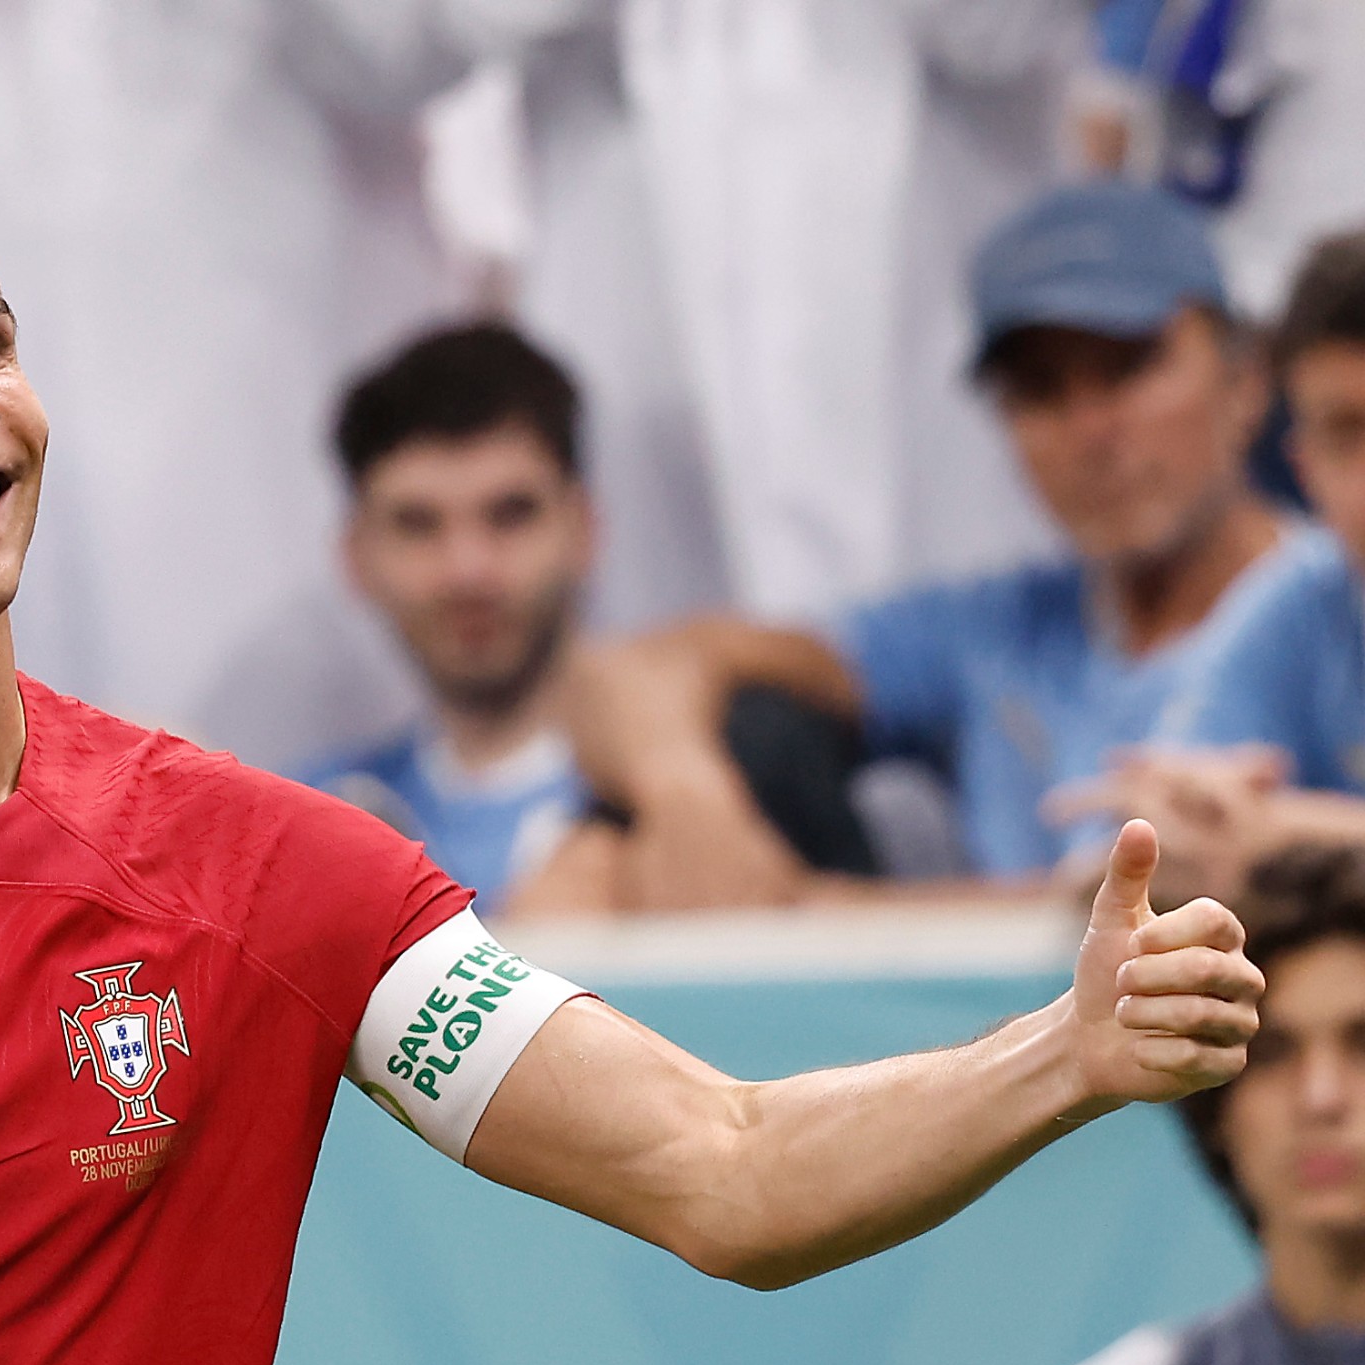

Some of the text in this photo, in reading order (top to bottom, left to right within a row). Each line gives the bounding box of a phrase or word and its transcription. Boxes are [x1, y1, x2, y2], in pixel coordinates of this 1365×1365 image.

[387, 986, 458, 1079] SAVE
[413, 954, 531, 1101] PLANE
[80, 1165, 98, 1183] 28
